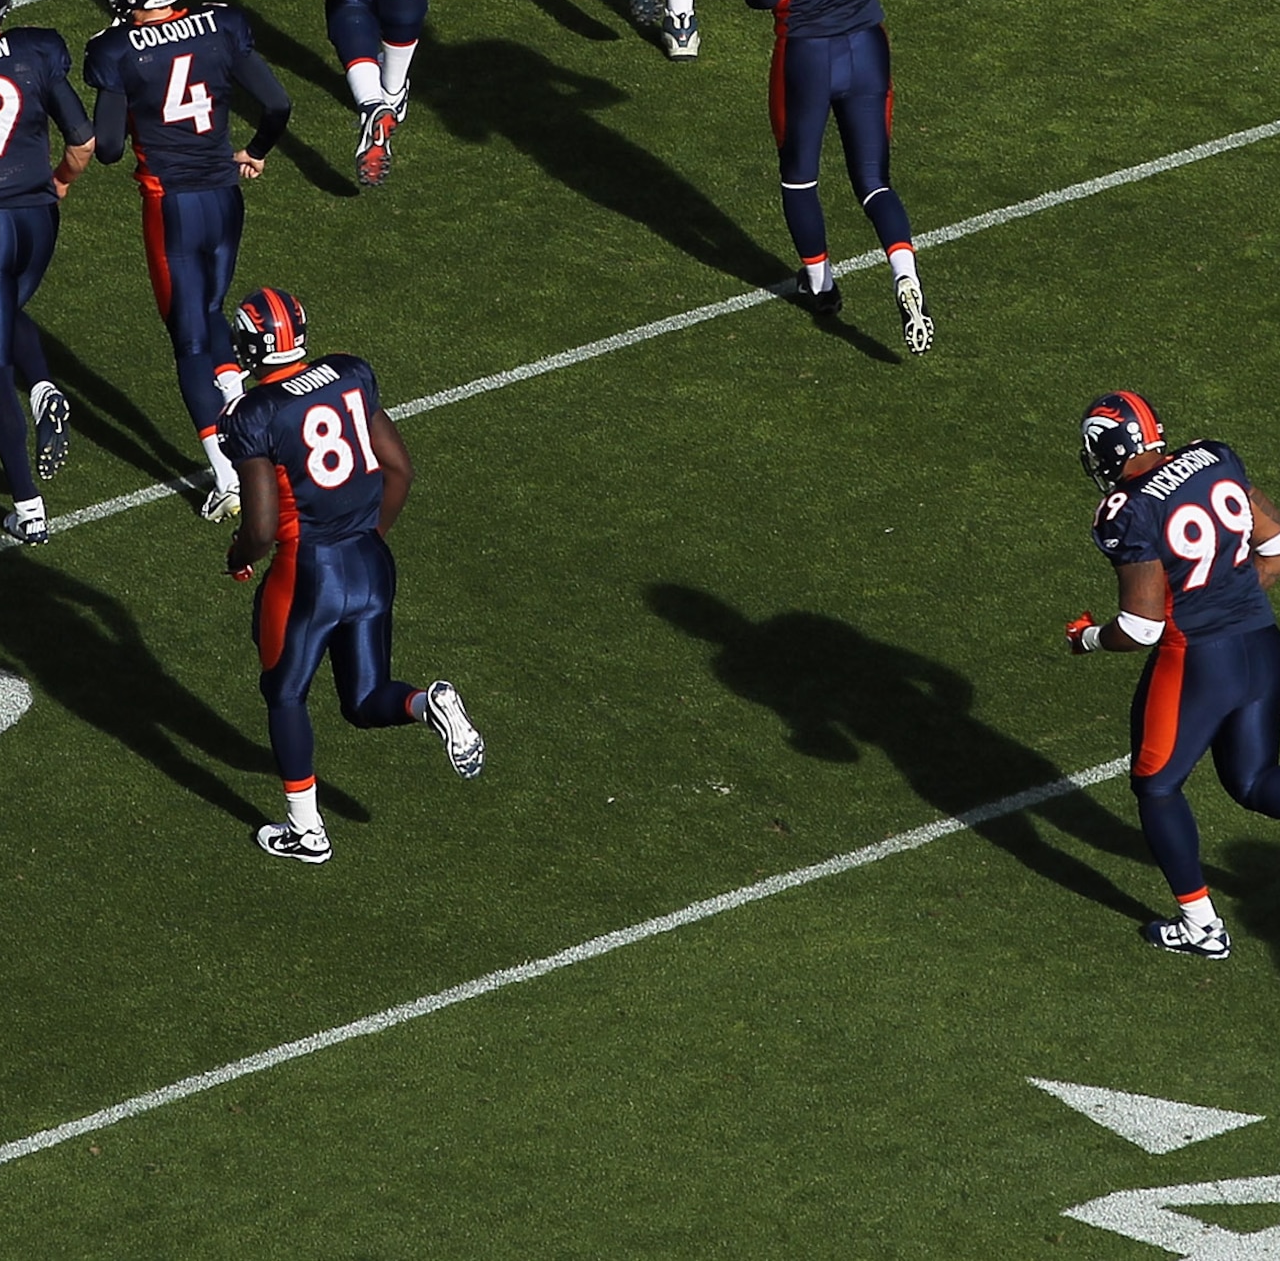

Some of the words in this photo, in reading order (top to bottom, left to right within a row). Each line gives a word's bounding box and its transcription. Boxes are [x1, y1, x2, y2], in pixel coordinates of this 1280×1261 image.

[128, 9, 218, 50] COLQUITT
[161, 53, 214, 135] 4
[281, 363, 341, 396] QUINN
[300, 388, 381, 490] 81
[1140, 446, 1220, 502] VICKERSON
[1163, 477, 1254, 591] 99
